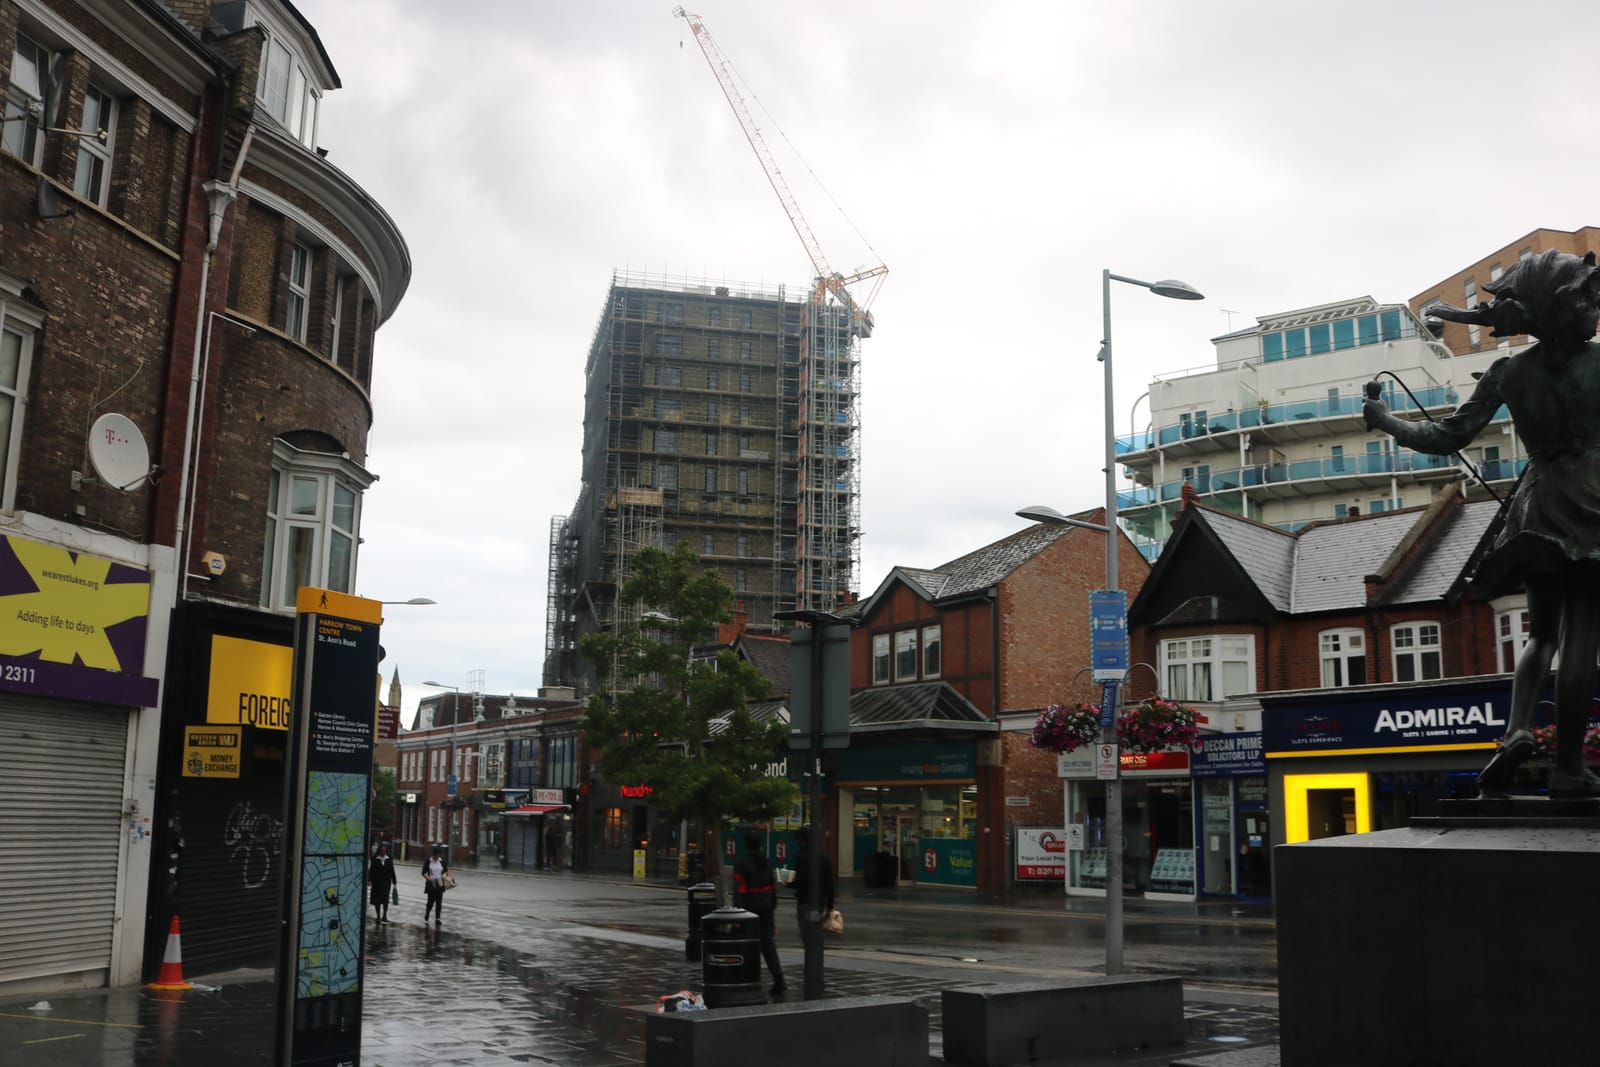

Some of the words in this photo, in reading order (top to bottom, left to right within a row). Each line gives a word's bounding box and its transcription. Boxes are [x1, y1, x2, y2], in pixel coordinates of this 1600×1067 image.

[42, 570, 99, 591] wearestlukes.org
[17, 610, 49, 628] Adding
[50, 615, 64, 628] life
[65, 621, 74, 630] to
[76, 621, 95, 635] days
[319, 619, 344, 629] HARROW
[346, 623, 362, 633] TOWN
[319, 627, 341, 637] CENTRE
[327, 636, 342, 645] Ann's
[343, 638, 356, 647] Road
[5, 665, 36, 683] 2311
[239, 693, 291, 728] FOREIG
[1374, 702, 1505, 733] ADMIRAL
[1204, 739, 1235, 753] DECCAN
[1237, 736, 1263, 750] PRIME
[210, 754, 233, 763] MONEY
[1207, 751, 1245, 762] SOLICITORS
[1247, 750, 1260, 760] LLP
[204, 763, 238, 773] EXCHANGE
[727, 840, 736, 855] £1
[776, 841, 786, 858] £1
[925, 852, 937, 868] £1
[949, 855, 974, 868] Value
